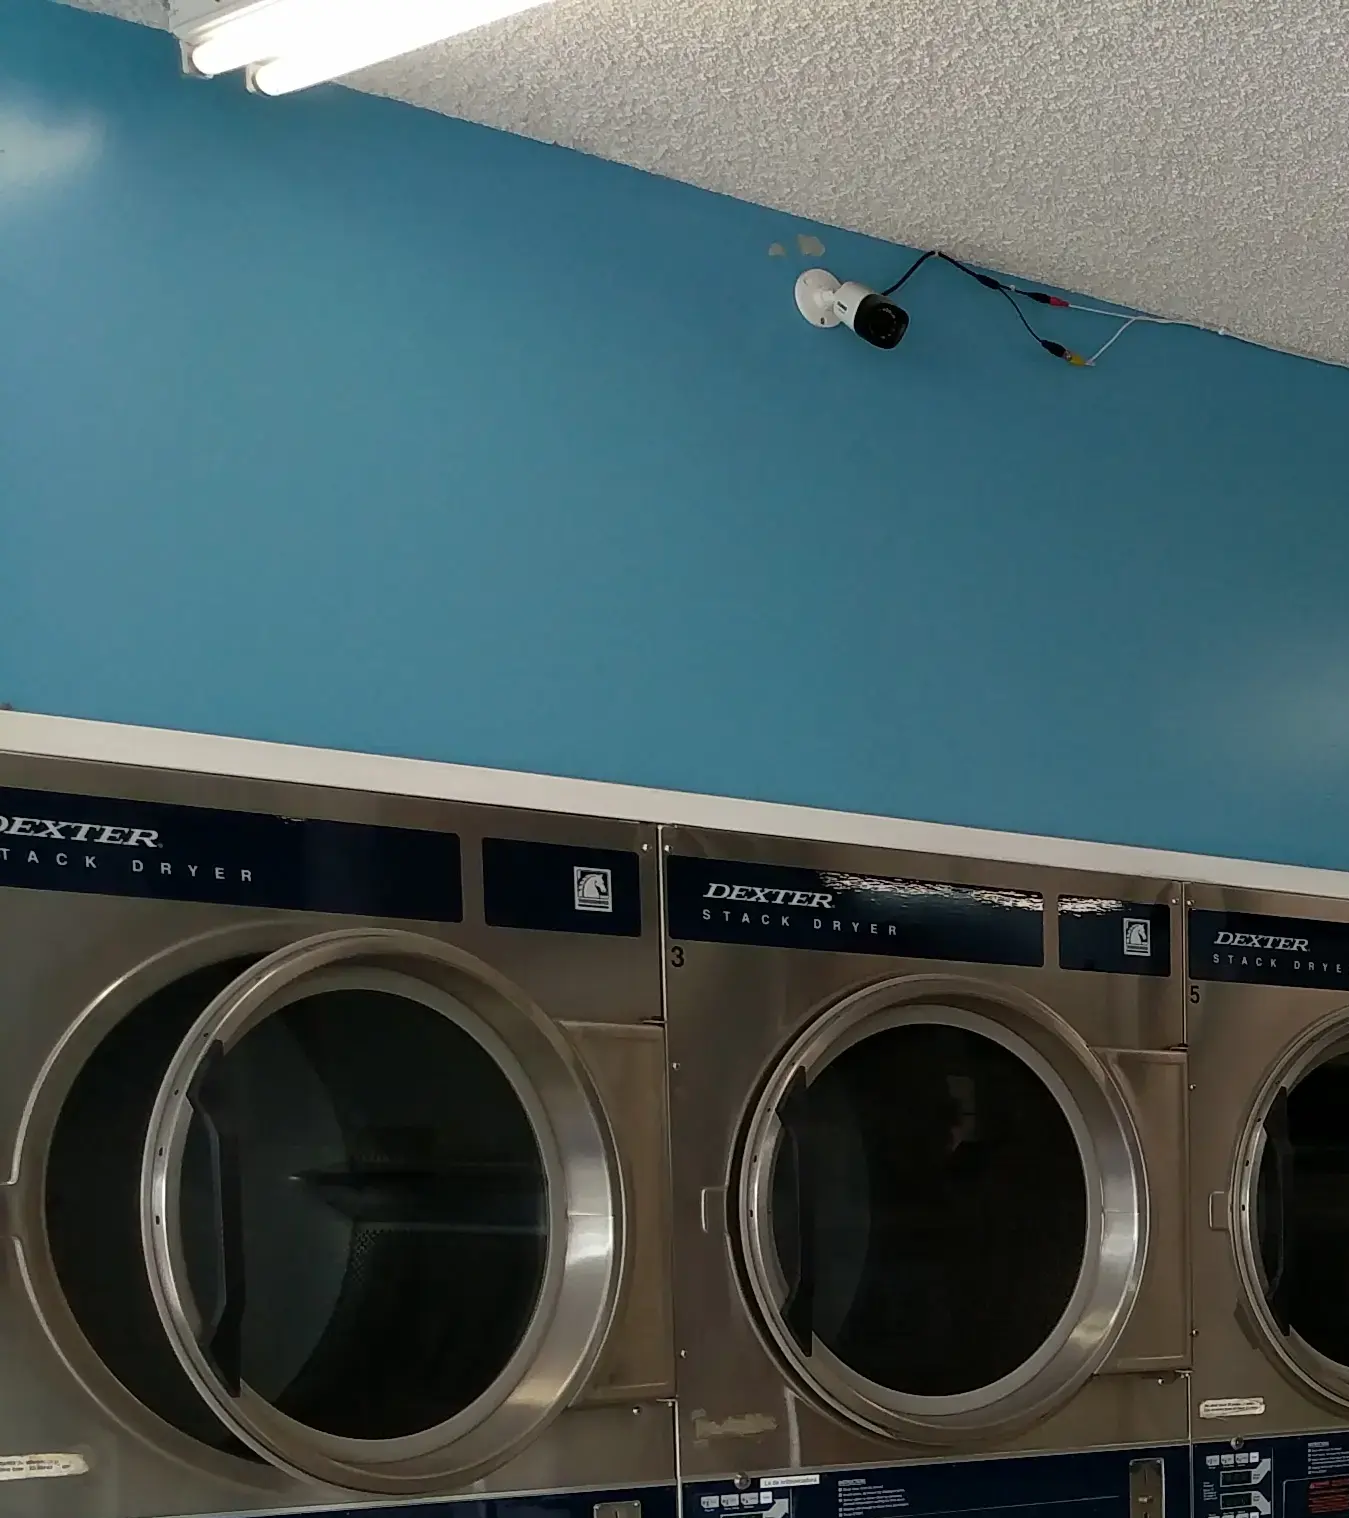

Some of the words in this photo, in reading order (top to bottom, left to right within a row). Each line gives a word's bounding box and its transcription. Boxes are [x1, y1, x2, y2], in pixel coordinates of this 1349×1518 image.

[133, 858, 254, 883] DRYER
[703, 882, 834, 909] DEXTER
[702, 909, 792, 927] STACK
[813, 917, 899, 936] DRYER
[1213, 931, 1311, 952] DEXTER
[671, 946, 686, 969] 3
[1212, 954, 1278, 968] STACK
[1189, 985, 1201, 1005] 5
